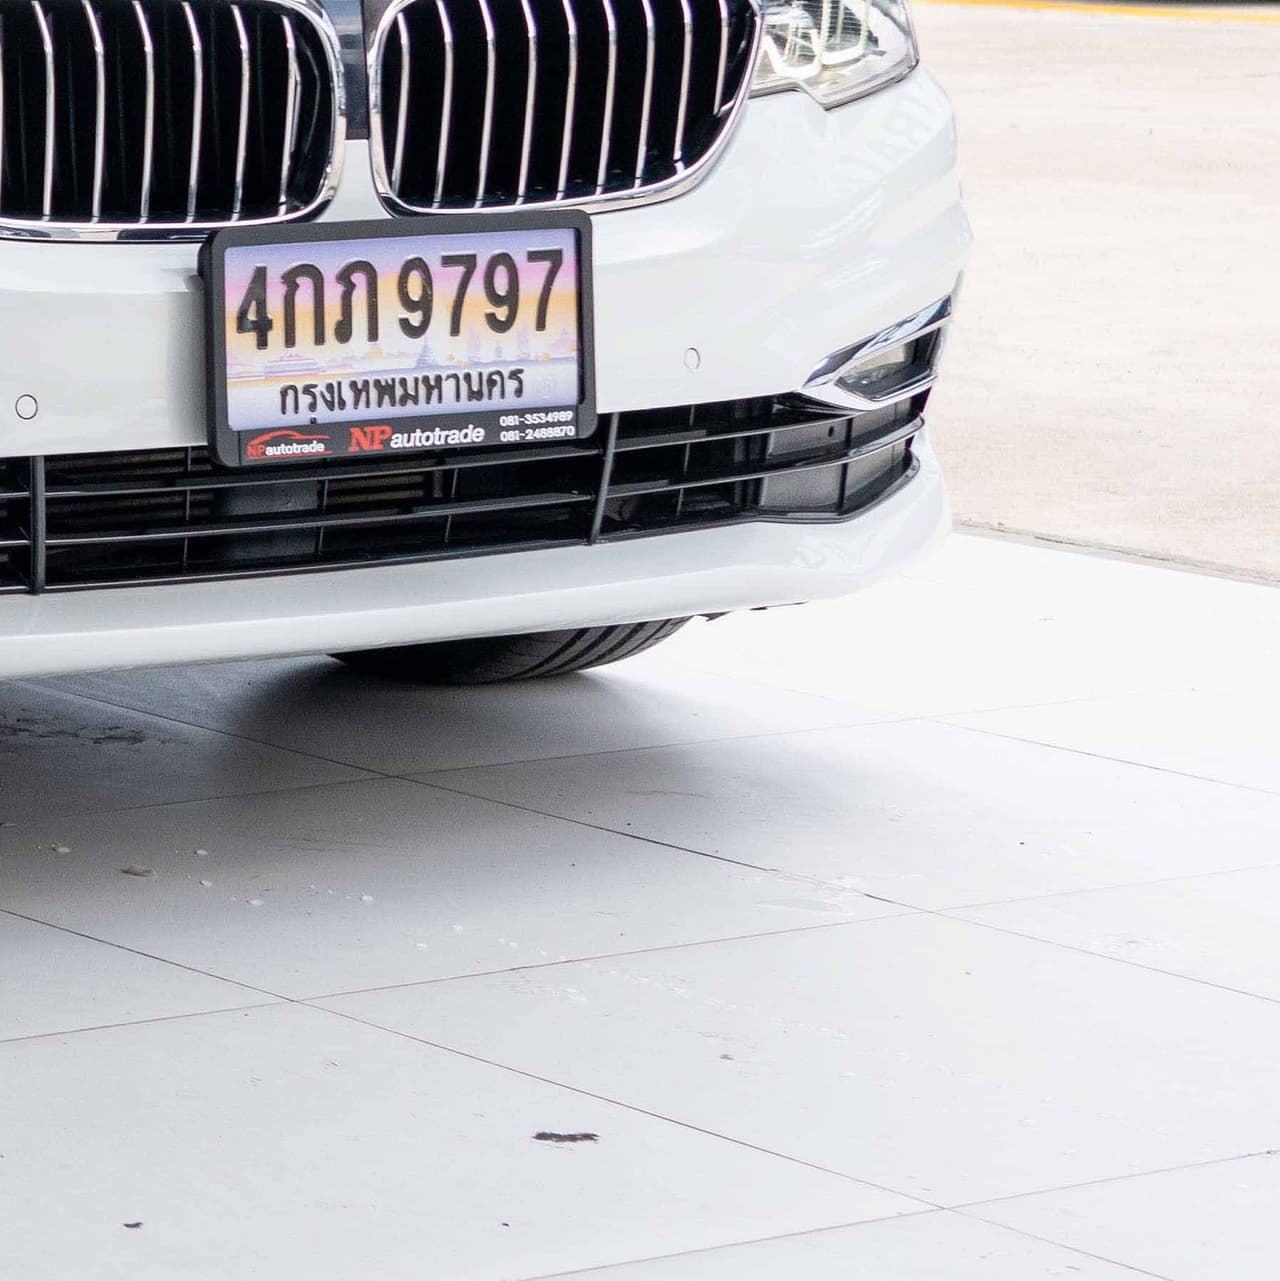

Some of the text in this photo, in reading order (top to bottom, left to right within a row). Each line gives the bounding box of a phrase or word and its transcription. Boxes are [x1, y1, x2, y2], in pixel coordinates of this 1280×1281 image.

[397, 247, 564, 340] 9797
[279, 367, 525, 425] กรุงเทพมหานคร
